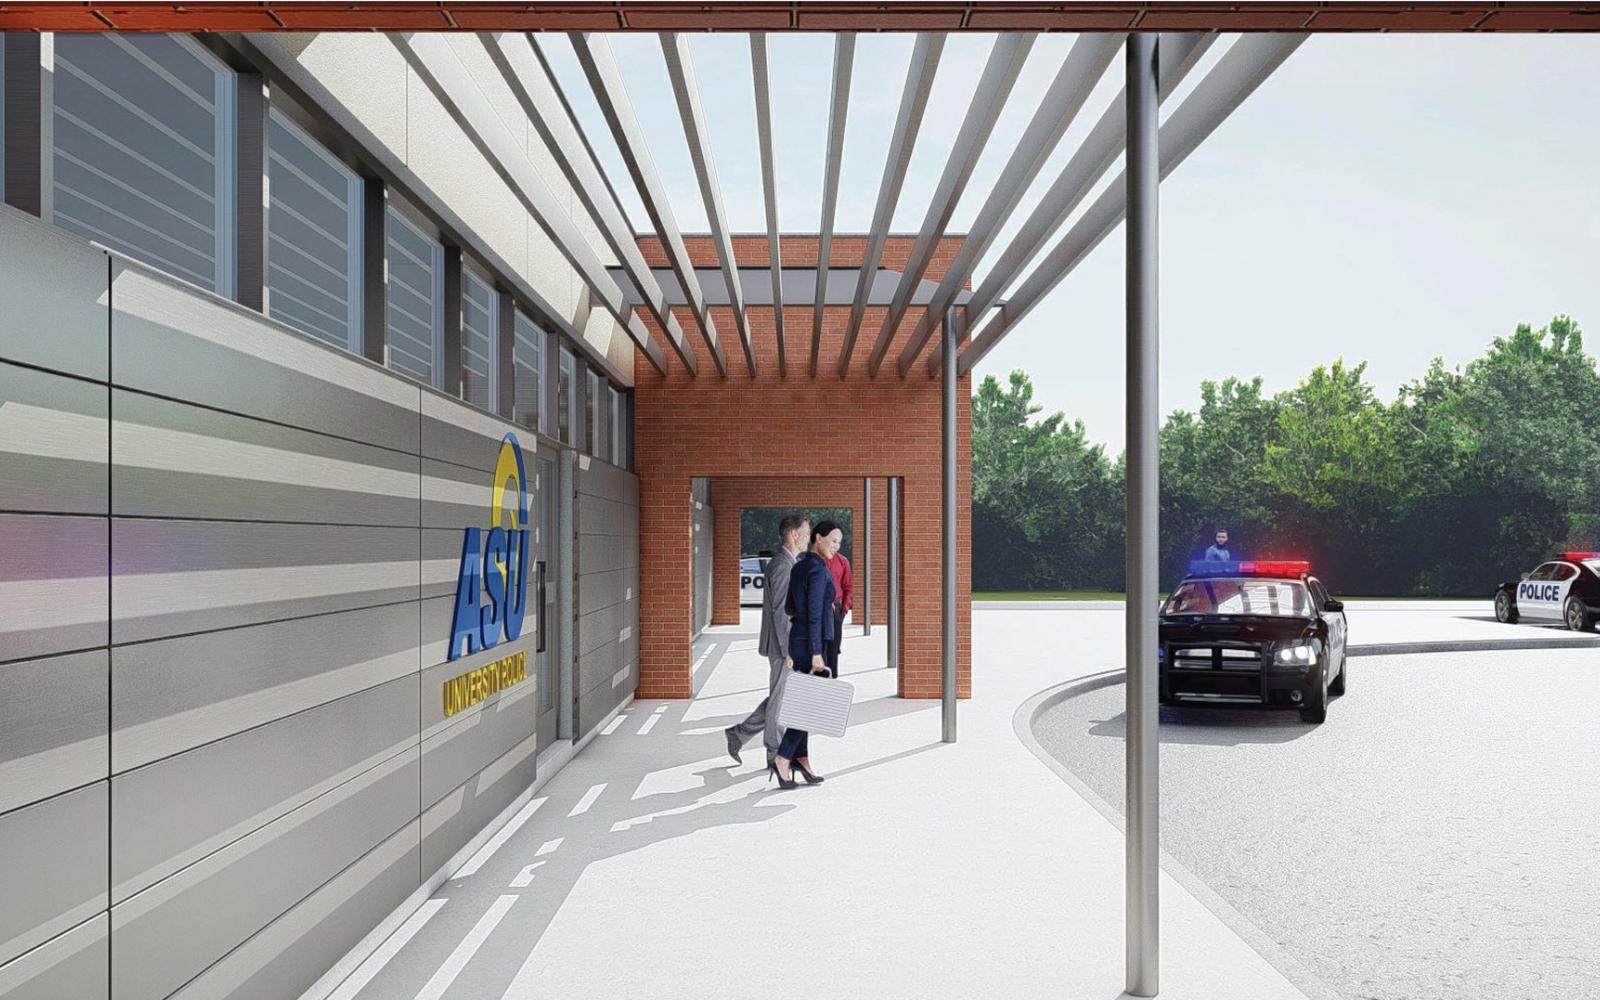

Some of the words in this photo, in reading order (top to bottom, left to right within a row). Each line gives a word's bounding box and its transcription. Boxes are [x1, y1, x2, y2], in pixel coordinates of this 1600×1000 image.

[447, 527, 530, 661] ASU
[1520, 583, 1560, 601] POLICE
[443, 660, 501, 717] UNIVERSITY
[501, 651, 528, 690] POLICE
